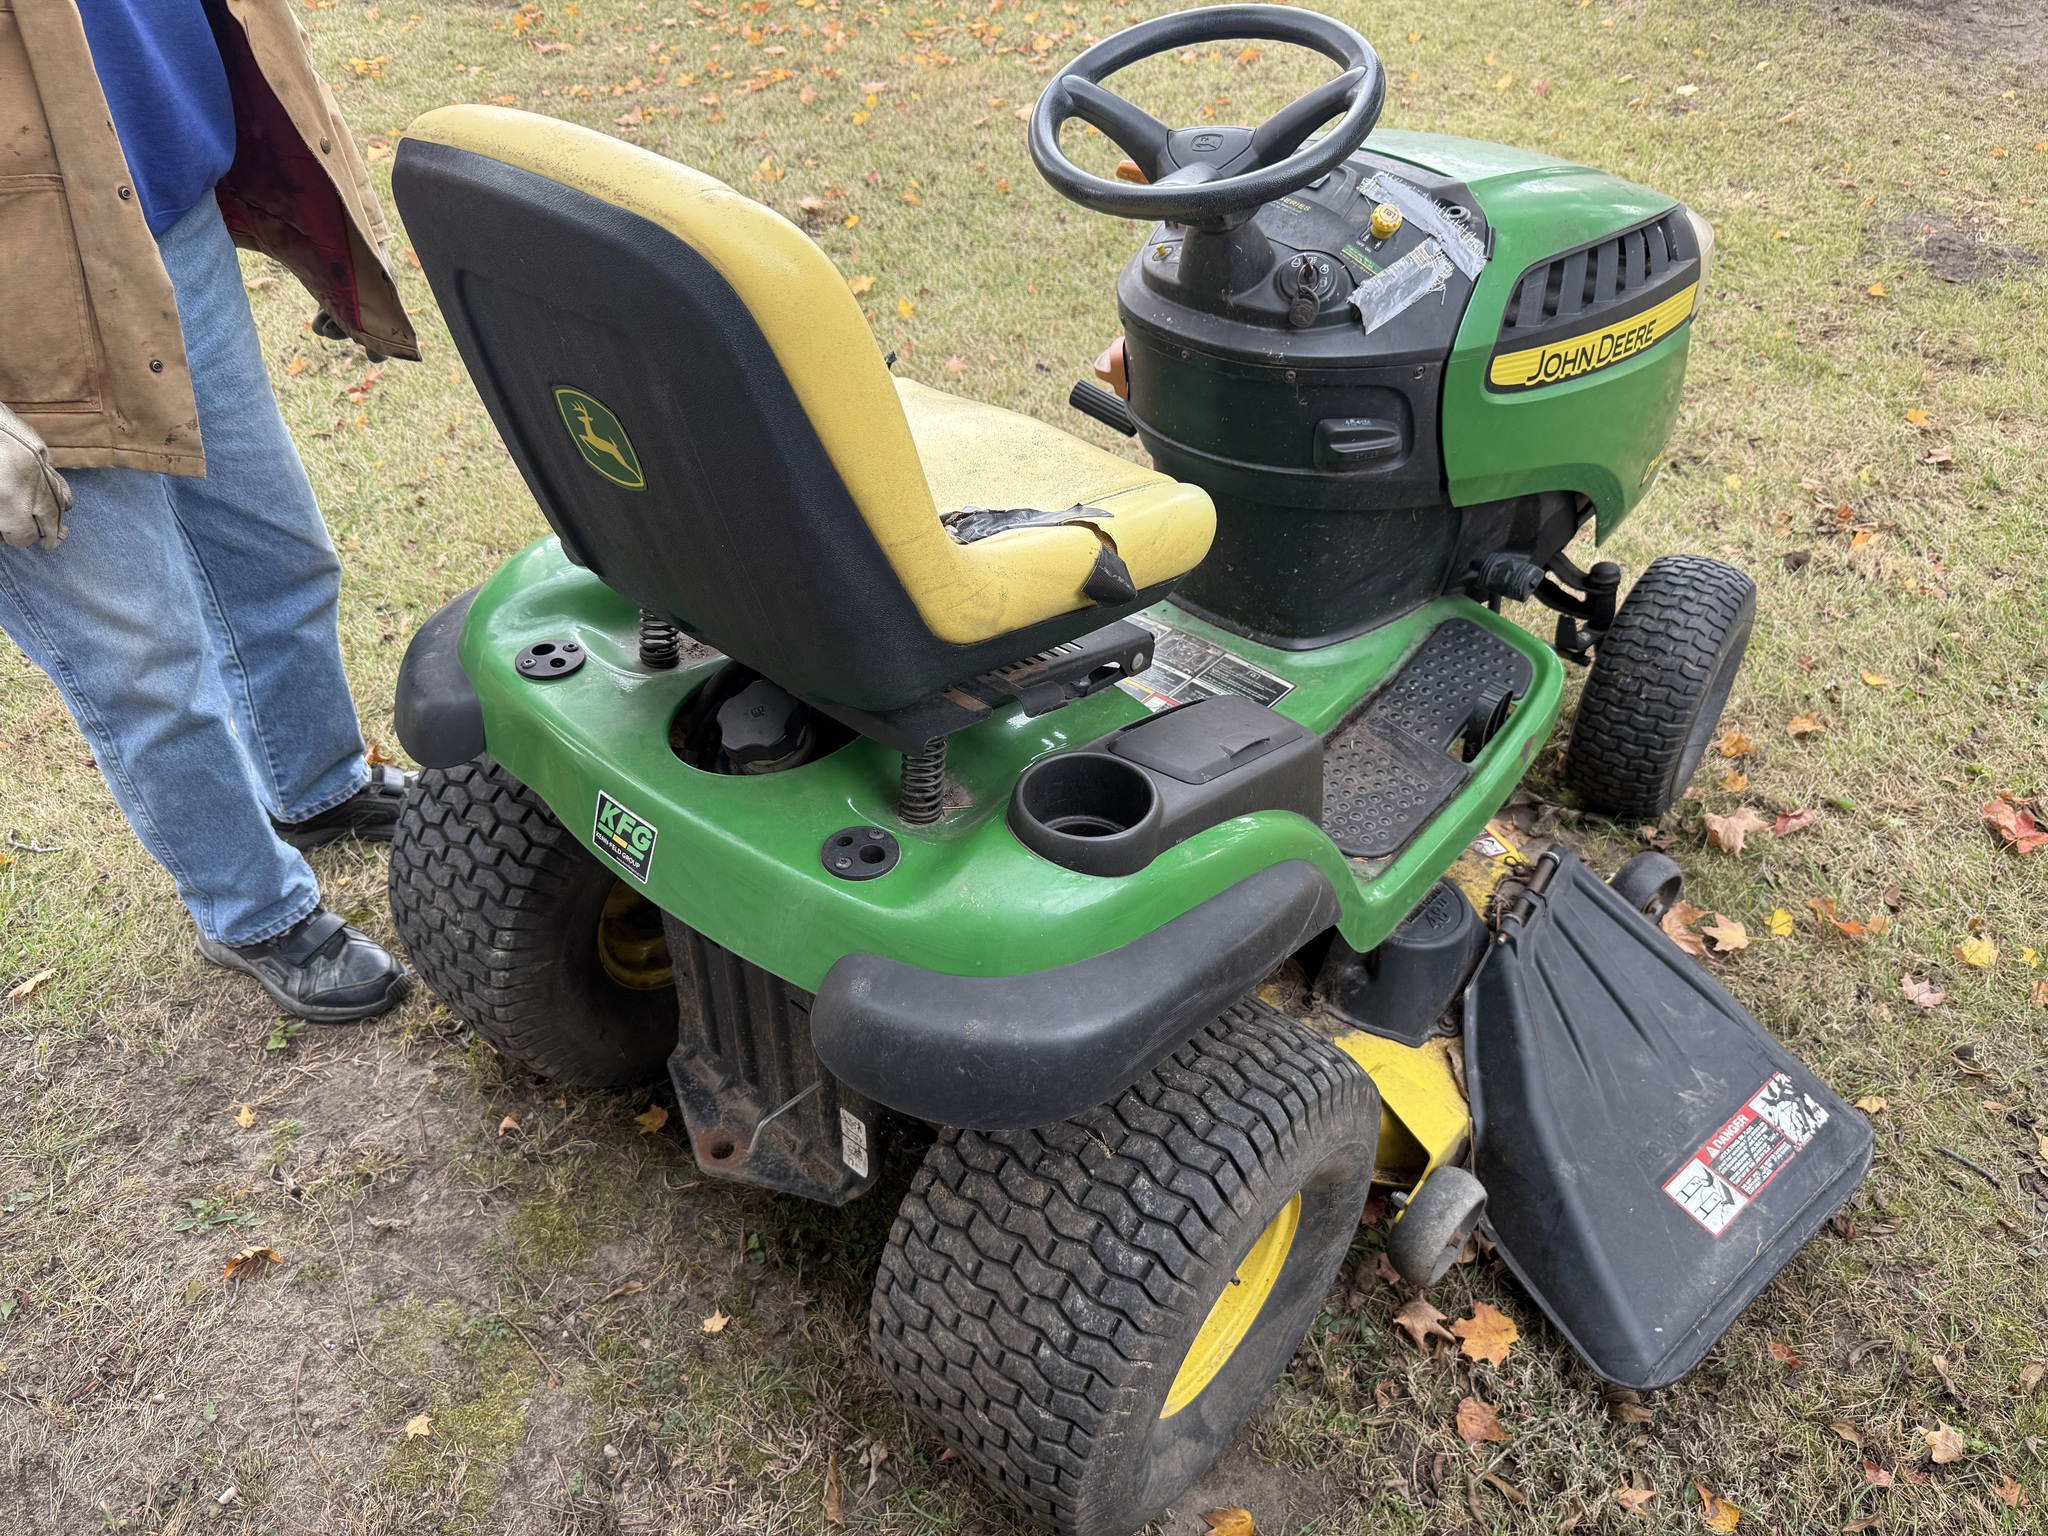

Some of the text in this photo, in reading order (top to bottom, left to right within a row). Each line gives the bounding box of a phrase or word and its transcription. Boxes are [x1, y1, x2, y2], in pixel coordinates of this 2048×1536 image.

[1526, 318, 1658, 383] JOHN DEERE
[600, 800, 653, 852] KFG
[621, 851, 641, 869] GROUP
[1711, 1113, 1750, 1149] DANGER
